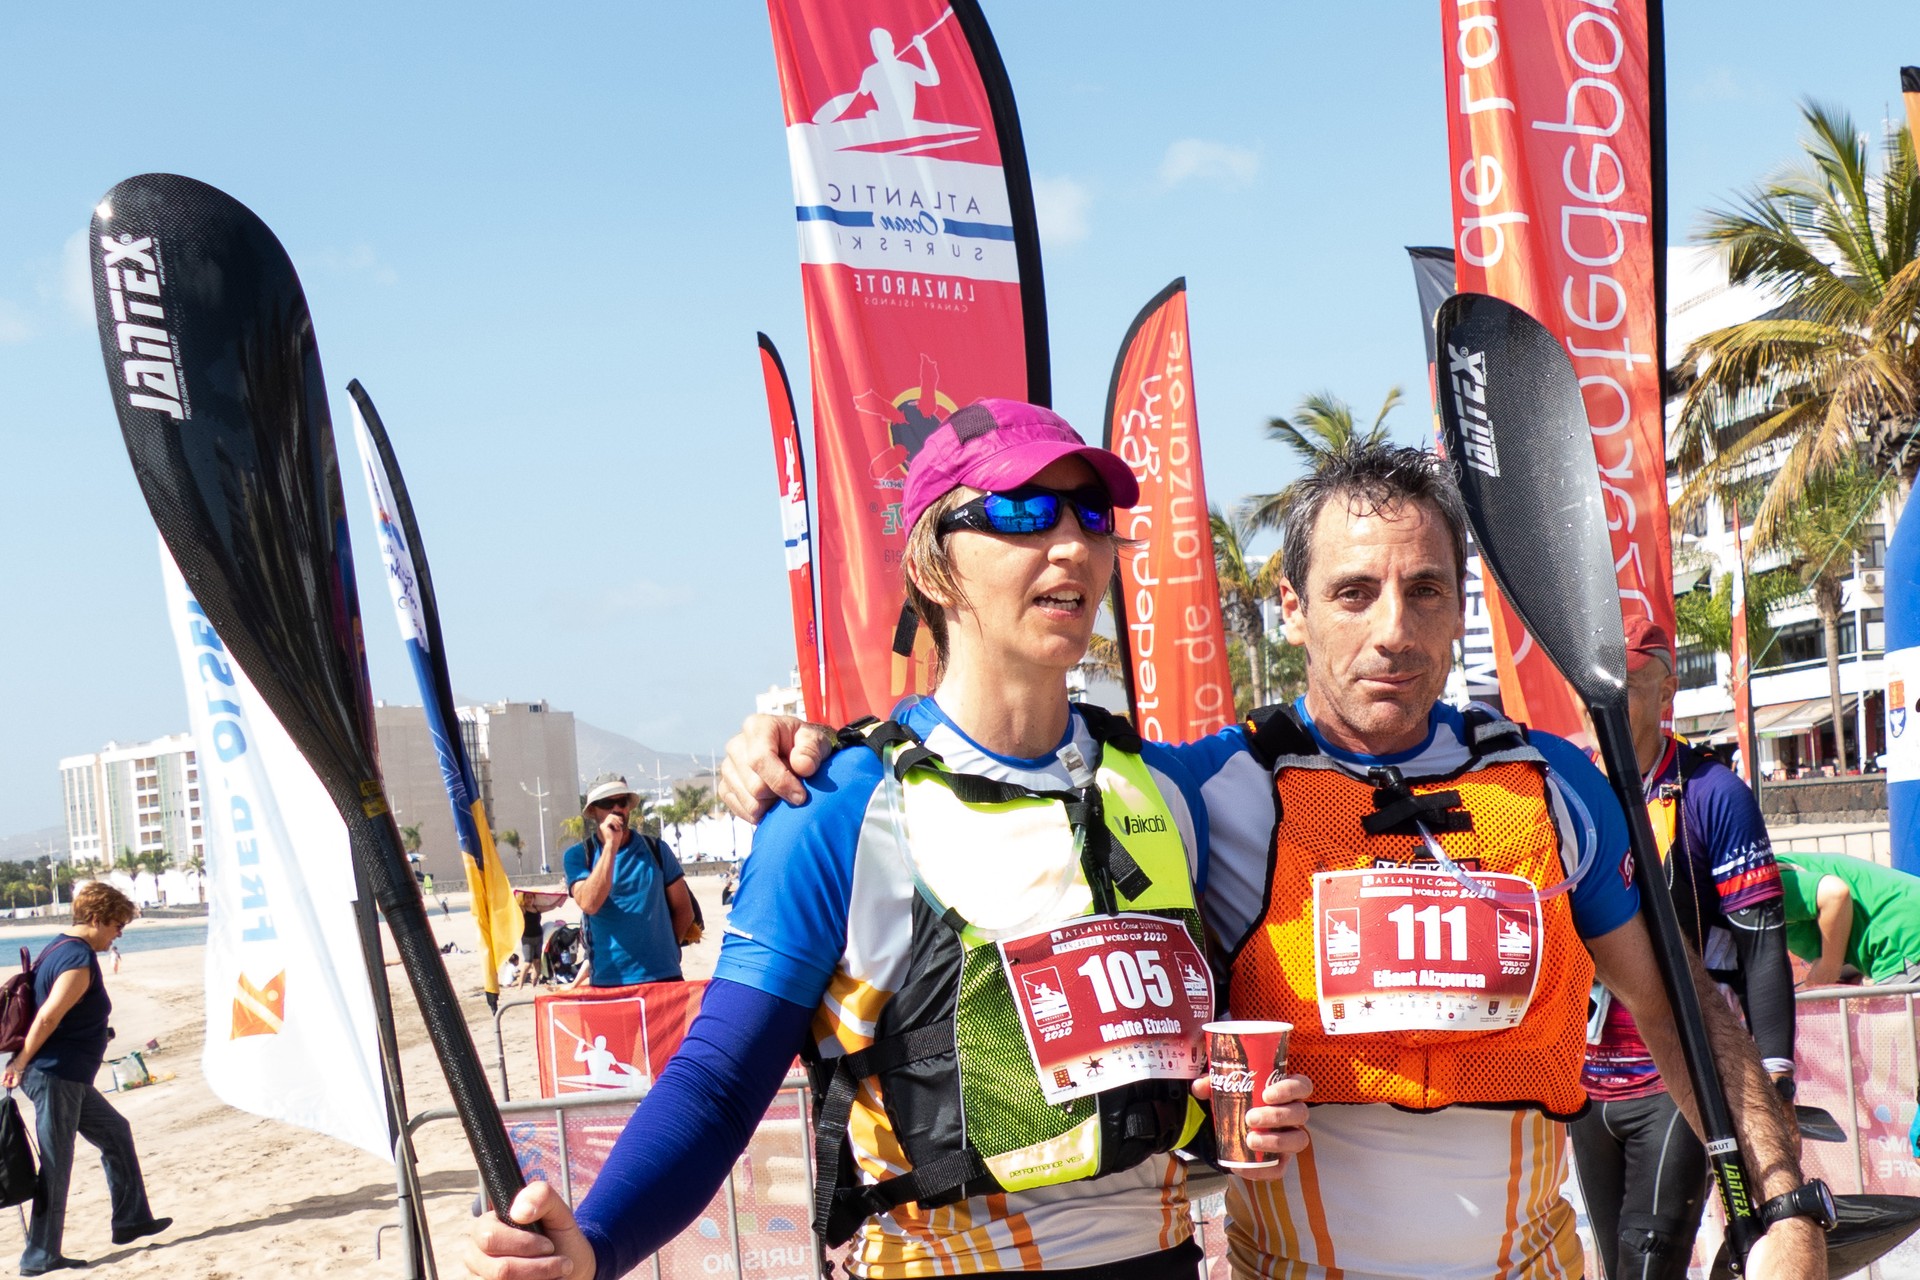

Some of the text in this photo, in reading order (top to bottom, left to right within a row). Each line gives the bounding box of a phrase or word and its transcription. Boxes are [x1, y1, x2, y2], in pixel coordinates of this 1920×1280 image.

[1168, 330, 1204, 585] Lanzarote
[1174, 604, 1216, 666] de
[1375, 877, 1433, 886] ATLANTIC
[1414, 888, 1440, 897] WORLD
[1441, 889, 1458, 897] CUP
[1066, 922, 1119, 938] ATLANTIC
[1105, 933, 1129, 943] WORLD
[1129, 932, 1142, 941] CUP
[1143, 931, 1168, 942] 2020
[1388, 904, 1467, 961] 111
[1501, 967, 1526, 976] 2020
[1077, 950, 1174, 1014] 105
[1193, 1010, 1208, 1019] 2020
[1038, 1019, 1074, 1035] WORLD CUP
[1043, 1027, 1072, 1042] 2020
[1100, 1017, 1182, 1043] Maite Etxabe
[1009, 1160, 1063, 1178] performance
